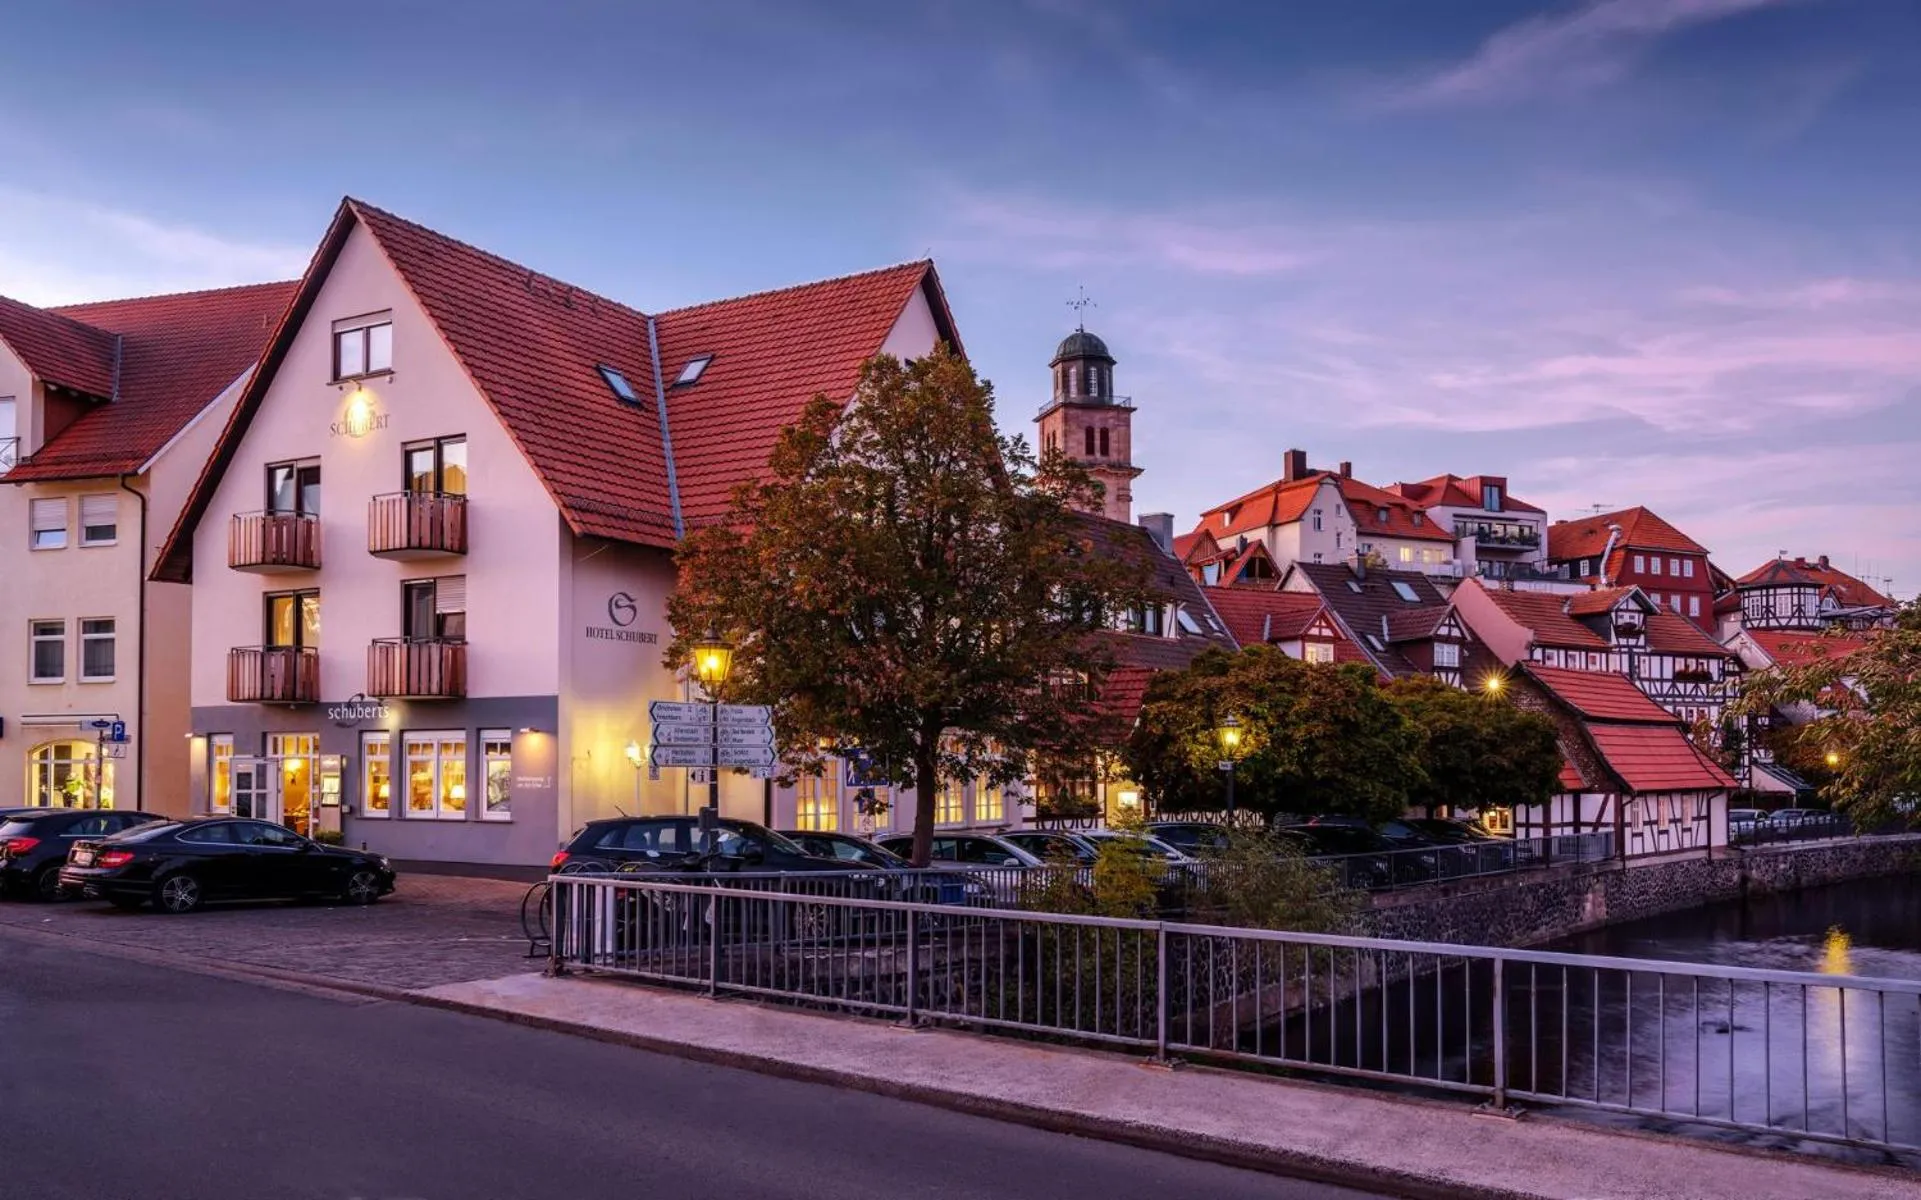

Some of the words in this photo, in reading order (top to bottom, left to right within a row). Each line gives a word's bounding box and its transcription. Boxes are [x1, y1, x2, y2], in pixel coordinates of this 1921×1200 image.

[330, 414, 390, 436] SCHERT
[586, 626, 615, 640] HOTEL
[615, 630, 658, 645] SCHUBERT
[328, 703, 389, 719] schuberts
[114, 724, 123, 741] P
